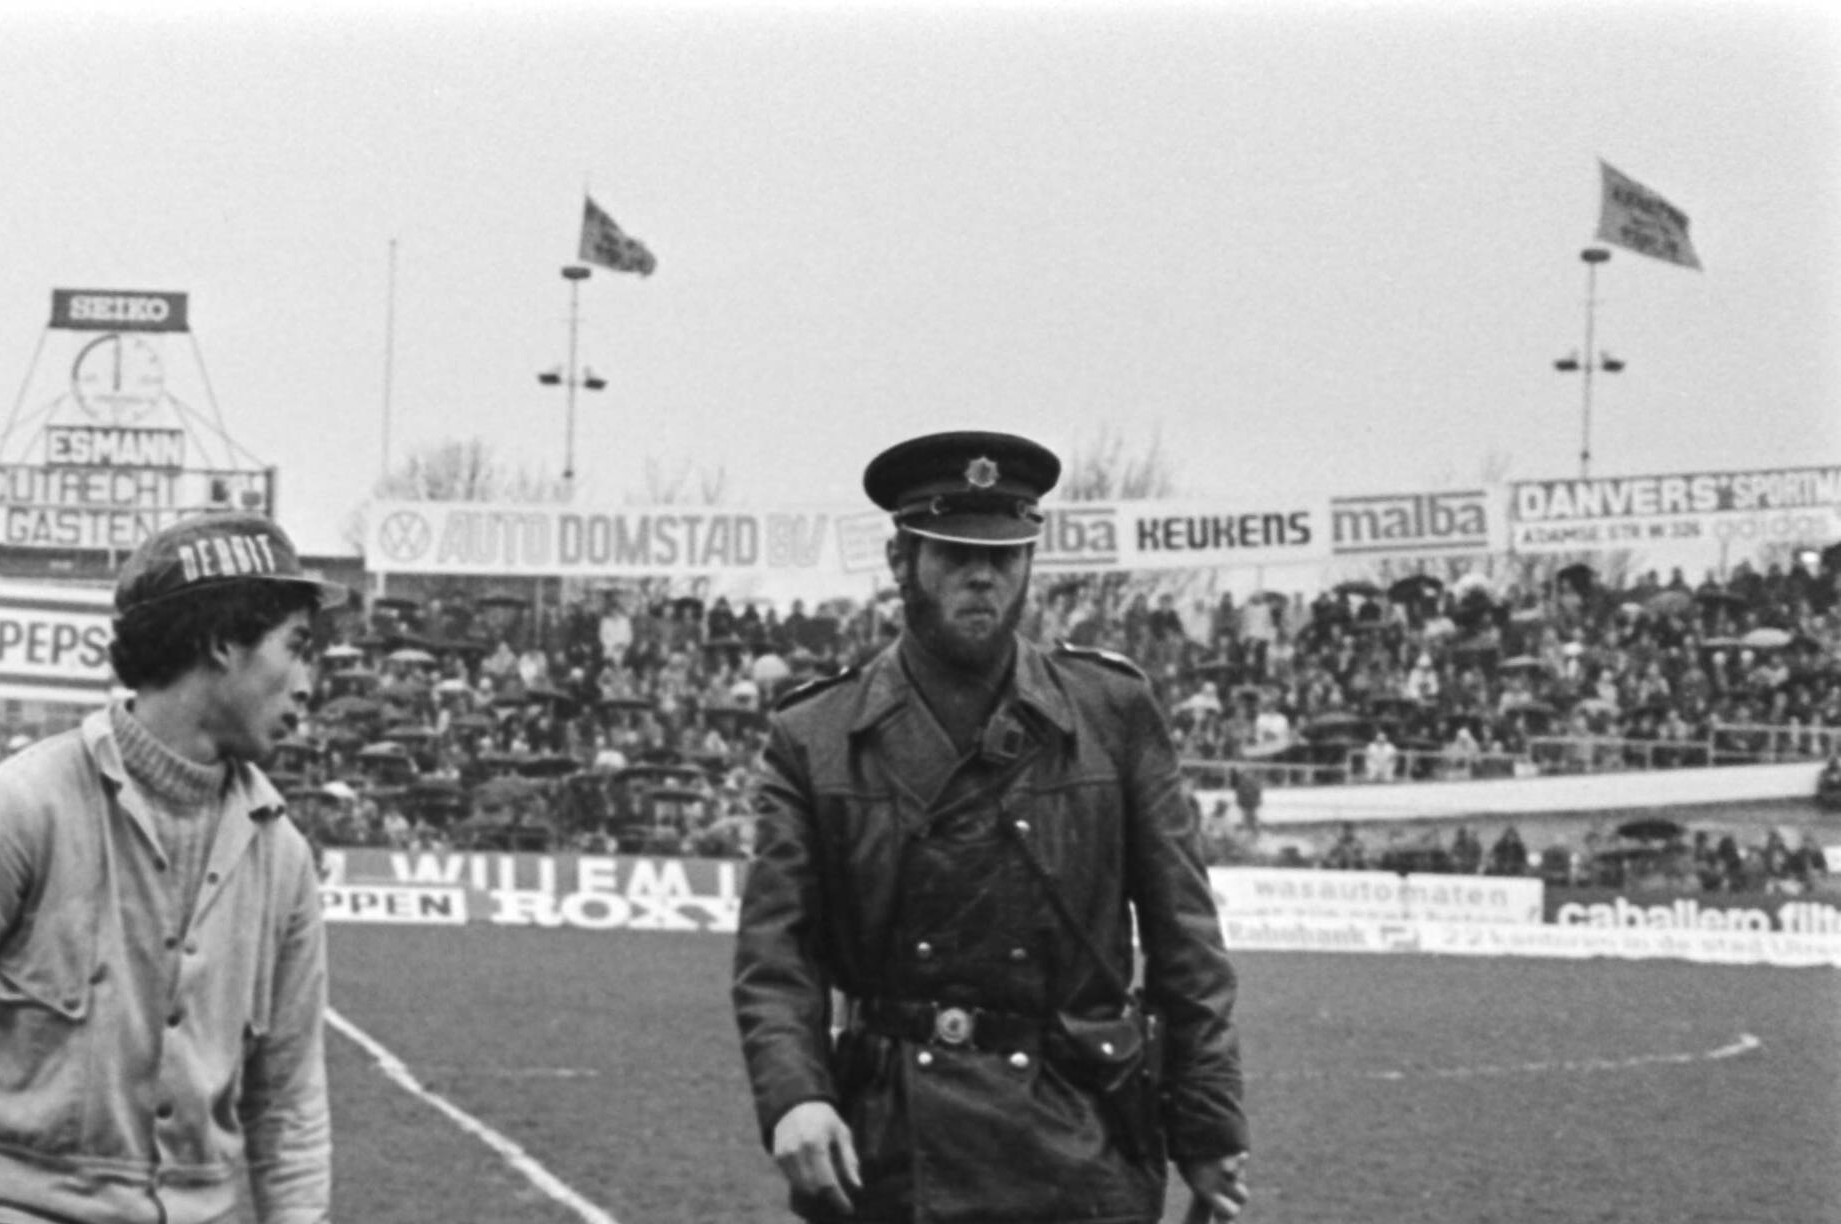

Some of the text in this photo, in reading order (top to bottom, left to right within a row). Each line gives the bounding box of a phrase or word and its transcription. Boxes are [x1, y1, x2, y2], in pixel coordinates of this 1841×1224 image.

[69, 295, 169, 322] SEIKO
[50, 429, 181, 467] ESMANN
[437, 509, 550, 567] AUTO
[558, 514, 759, 566] DOMSTAD
[1040, 508, 1116, 552] lba
[1136, 511, 1312, 552] KEUKENS
[1332, 496, 1488, 542] malba
[390, 851, 691, 900] WILLEM
[1556, 896, 1772, 932] caballero
